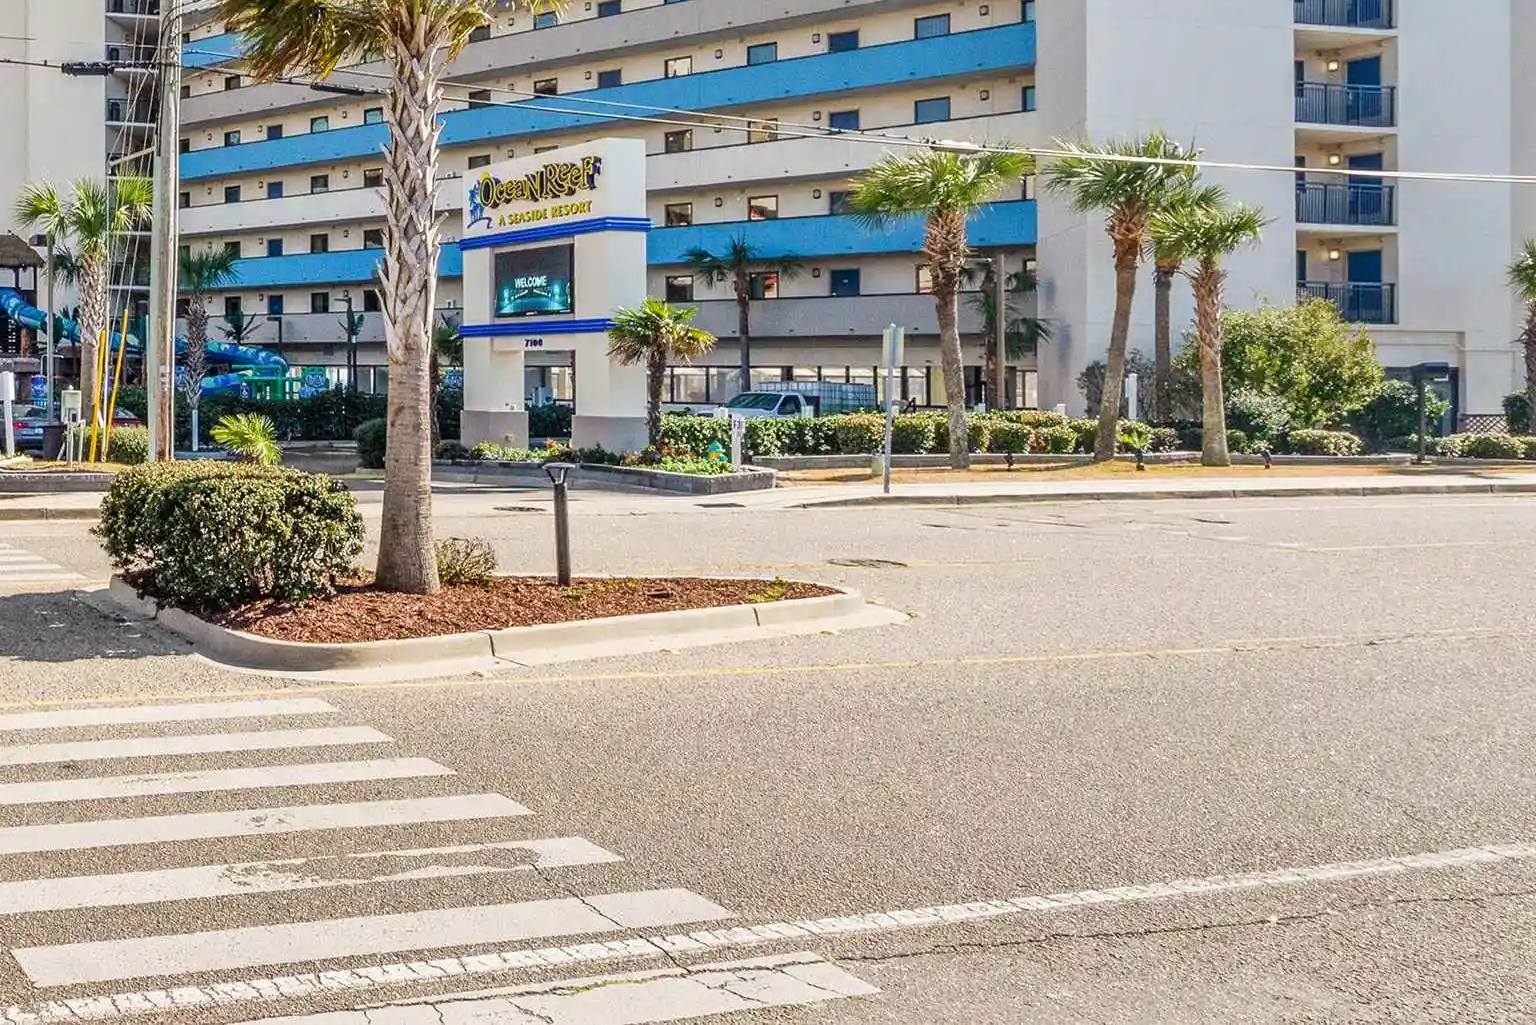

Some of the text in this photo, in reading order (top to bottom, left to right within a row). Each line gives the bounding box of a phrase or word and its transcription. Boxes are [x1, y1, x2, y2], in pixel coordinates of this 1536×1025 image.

[499, 200, 592, 227] A SEASIDE RESORT
[515, 275, 547, 288] WELCOME
